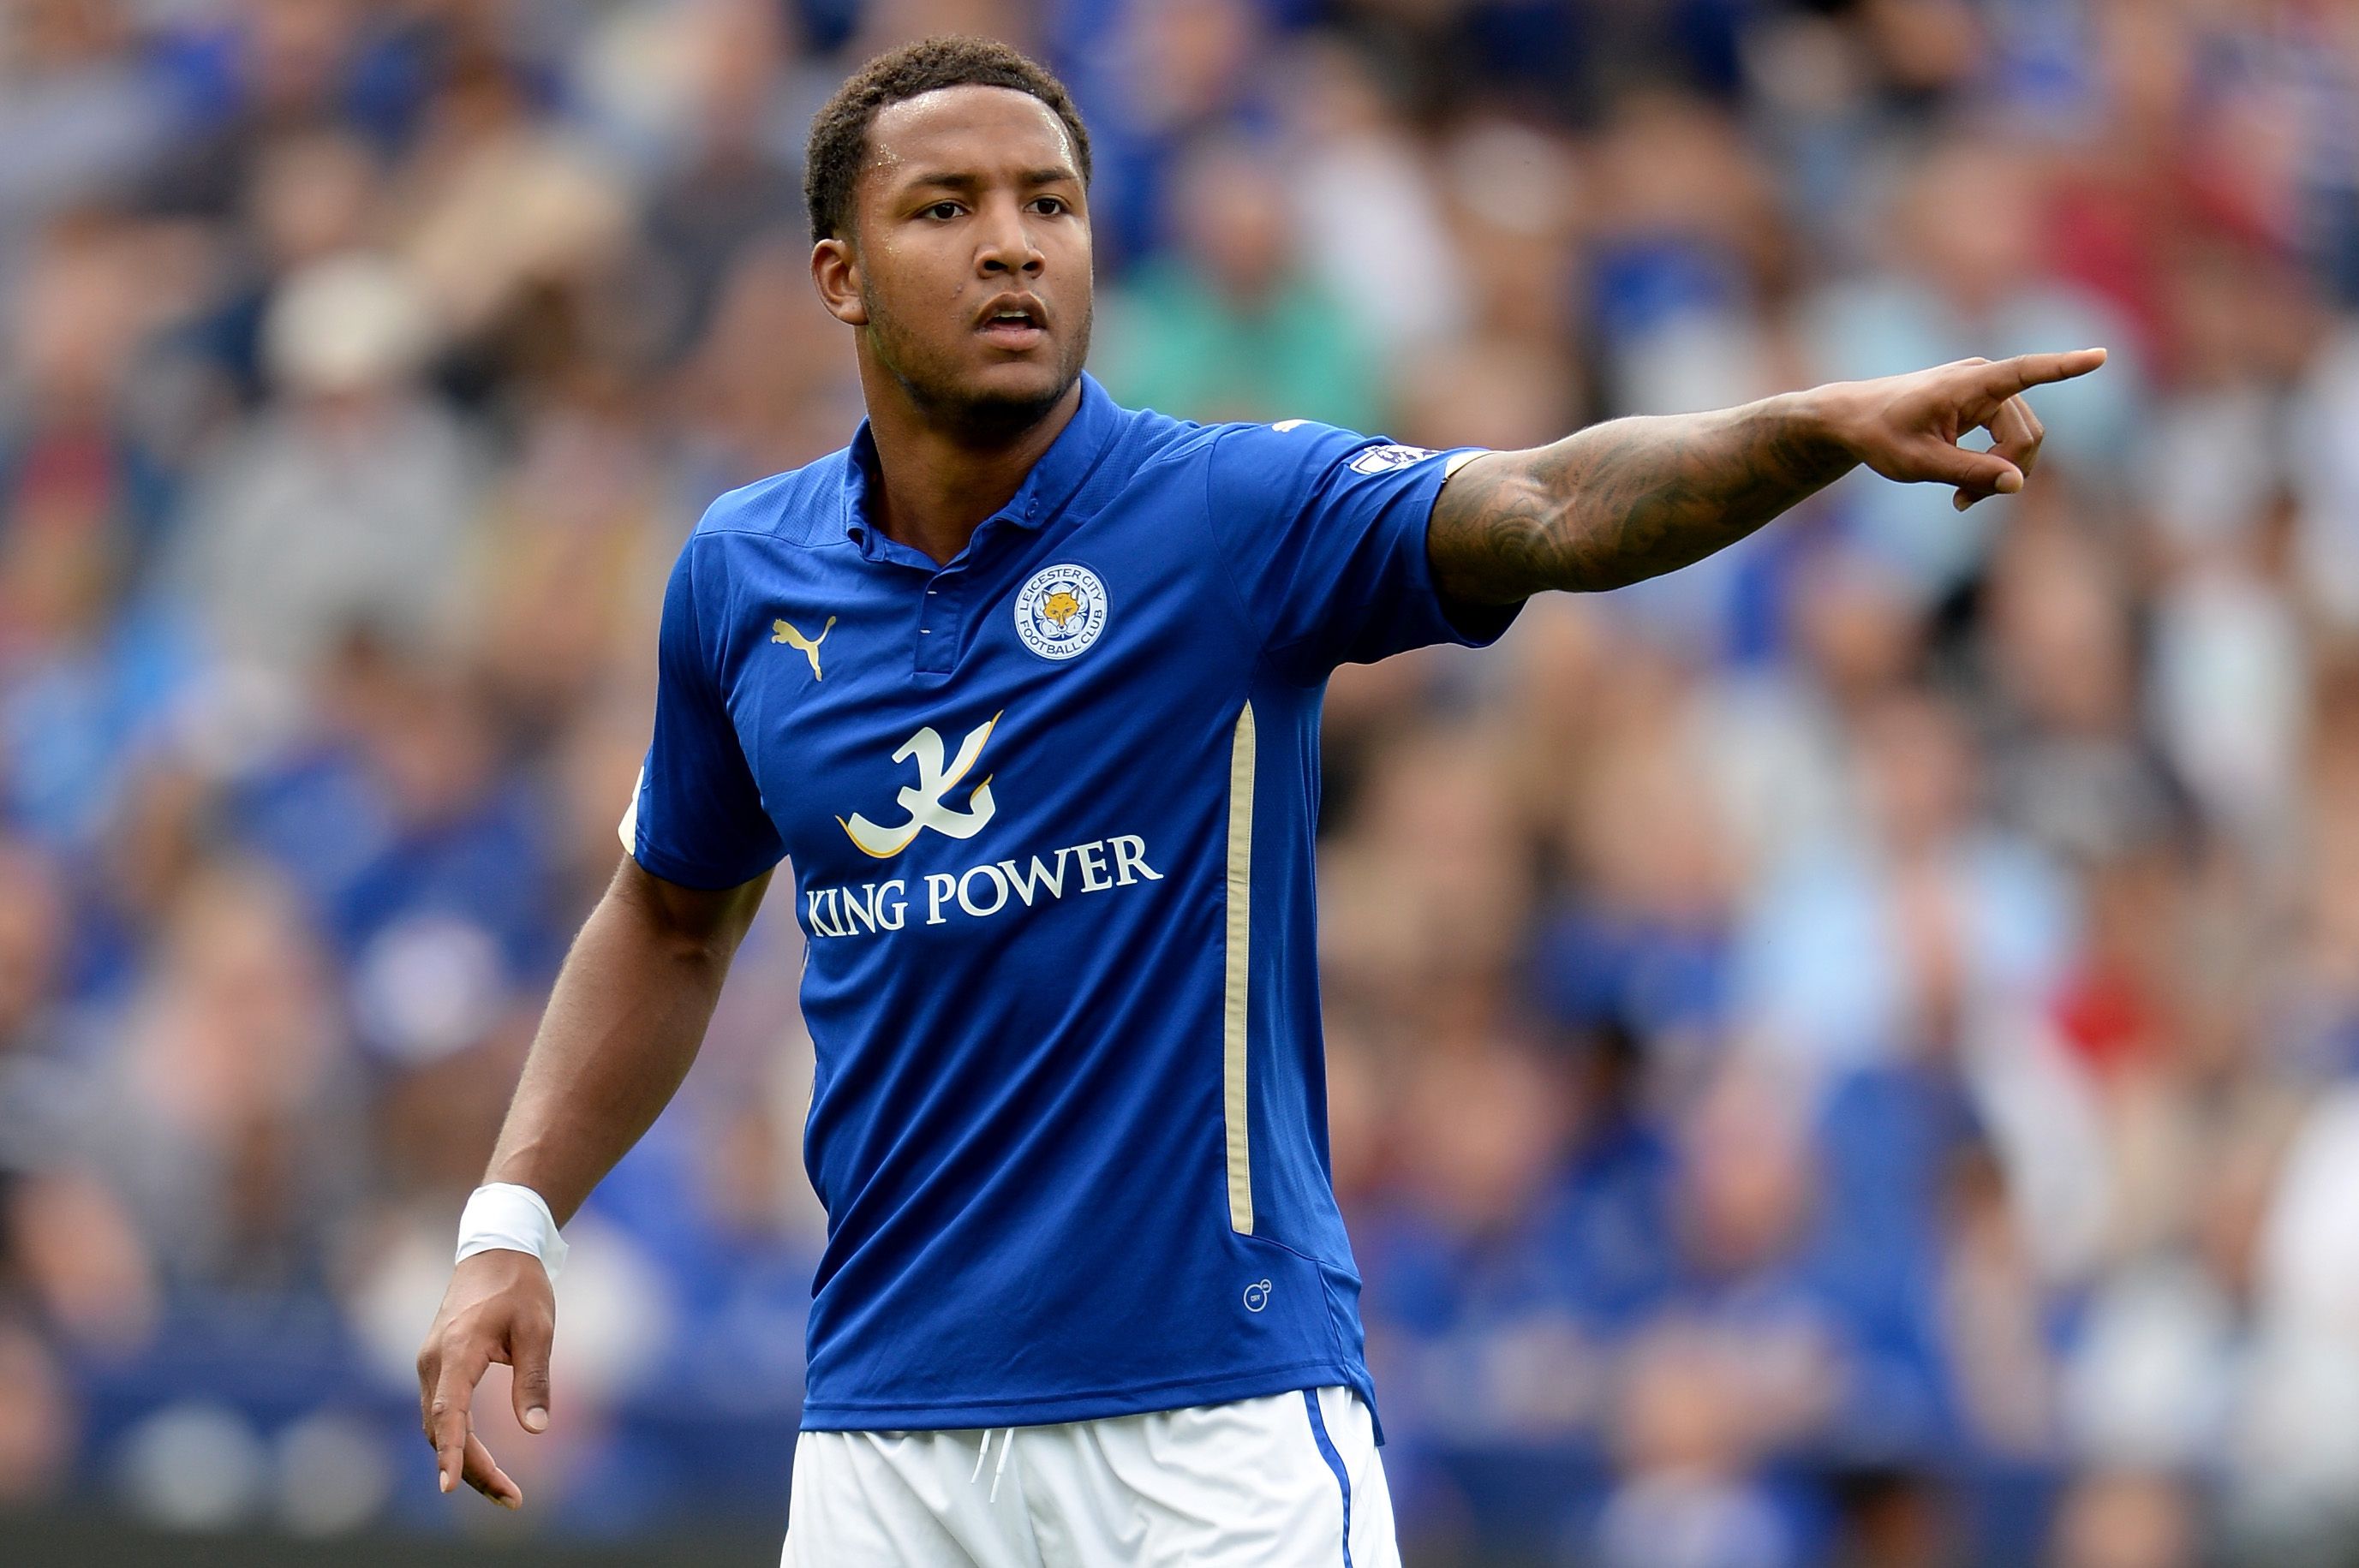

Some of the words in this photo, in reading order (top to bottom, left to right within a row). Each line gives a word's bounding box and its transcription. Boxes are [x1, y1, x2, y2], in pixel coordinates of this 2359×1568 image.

[1019, 568, 1081, 611] LEICESTER
[1082, 575, 1102, 601] CITY
[1019, 619, 1081, 655] FOOTBALL
[1080, 609, 1103, 644] CLUB
[807, 879, 909, 937] KING
[923, 834, 1164, 925] POWER
